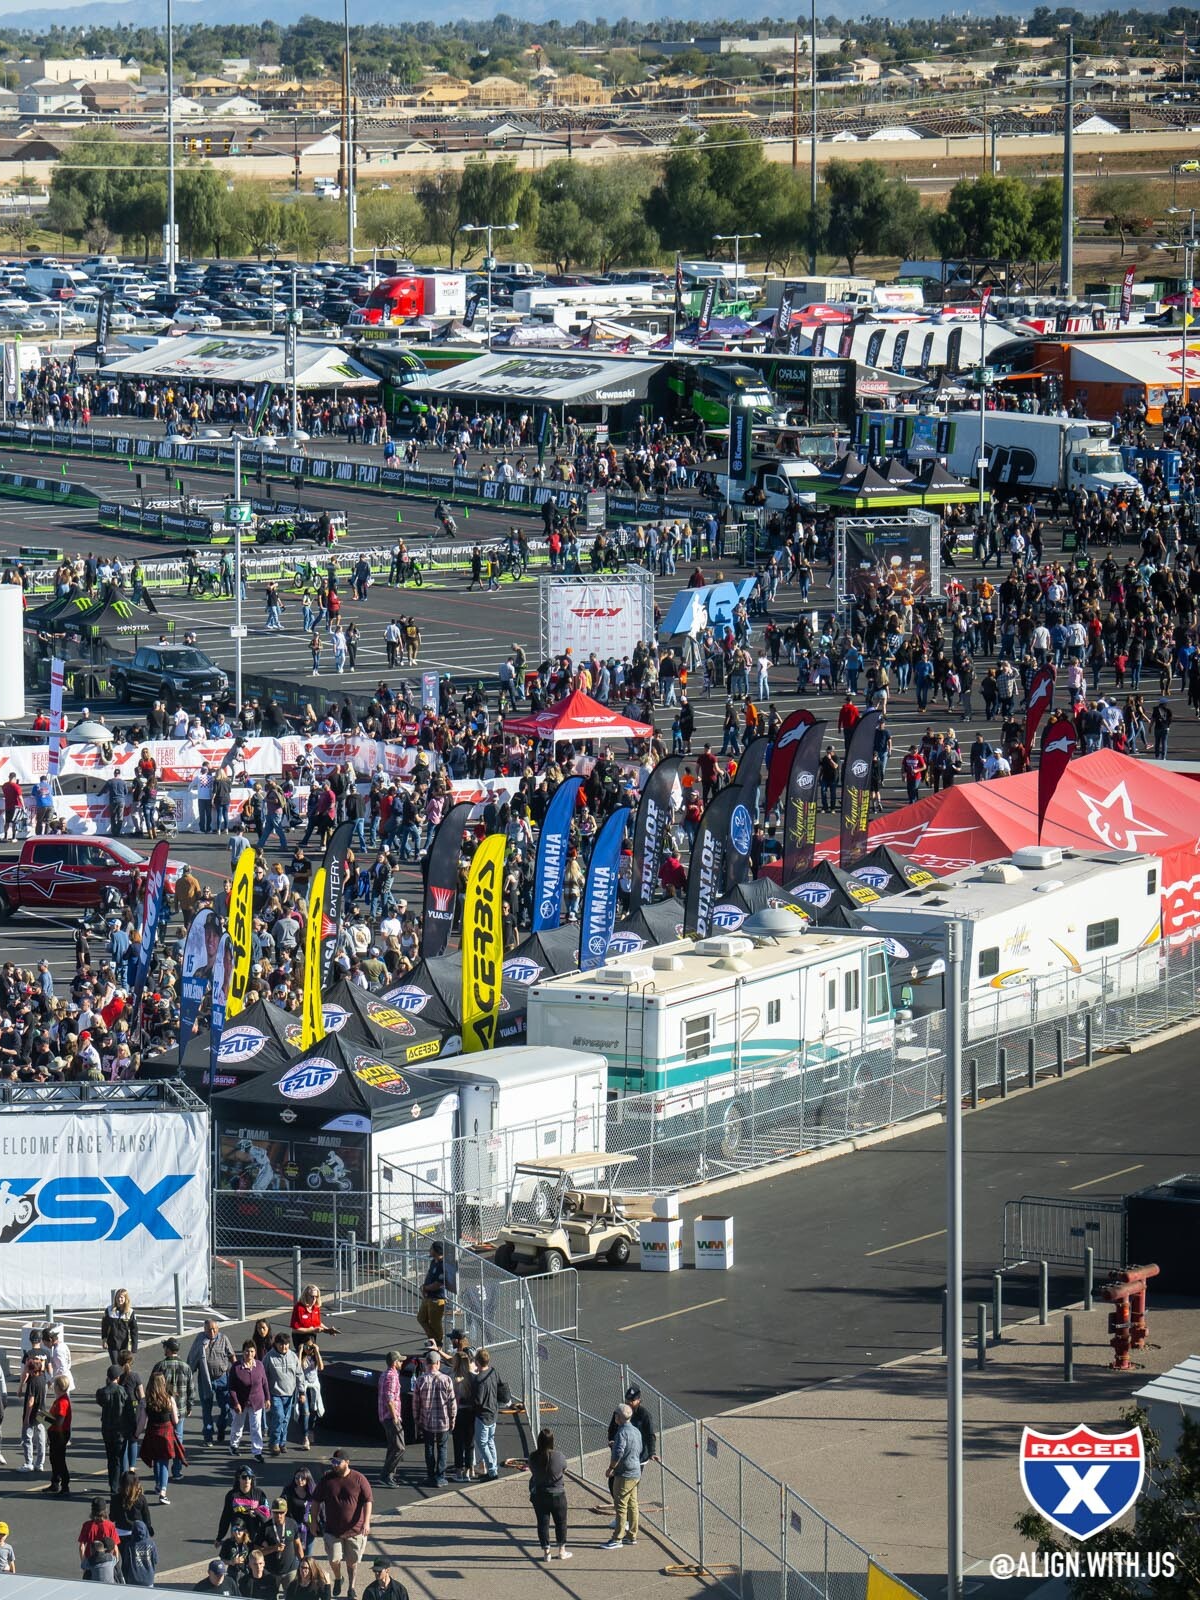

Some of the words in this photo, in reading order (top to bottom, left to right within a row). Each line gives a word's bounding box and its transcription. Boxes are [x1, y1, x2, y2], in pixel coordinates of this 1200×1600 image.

[596, 388, 635, 400] Kawasaki
[735, 416, 743, 460] Kawasaki
[117, 439, 129, 453] GET
[138, 441, 150, 455] OUT
[158, 442, 171, 458] AND
[178, 445, 194, 461] PLAY
[290, 458, 304, 474] GET
[313, 461, 327, 476] OUT
[336, 463, 352, 479] AND
[359, 466, 378, 483] PLAY
[484, 482, 499, 498] GET
[509, 484, 524, 502] OUT
[534, 488, 551, 504] AND
[230, 507, 249, 521] 87
[570, 607, 623, 618] FLY
[570, 716, 616, 724] FLY
[33, 753, 49, 763] FEAR
[158, 749, 174, 757] FEAR
[158, 757, 175, 765] LESS
[33, 763, 48, 772] LESS
[860, 790, 870, 832] HEROES
[807, 802, 816, 844] HEROES
[640, 799, 659, 901] DUNLOP
[542, 833, 562, 899] YAMAHA
[696, 829, 718, 938] DUNLOP
[590, 867, 610, 934] YAMAHA
[186, 955, 194, 972] 15
[183, 983, 203, 999] WILSON
[500, 1026, 517, 1037] YUASA
[355, 1065, 396, 1079] MOTO
[67, 1135, 102, 1154] RACE
[111, 1134, 153, 1153] FANS!
[642, 1241, 667, 1251] WM
[697, 1240, 724, 1249] WM
